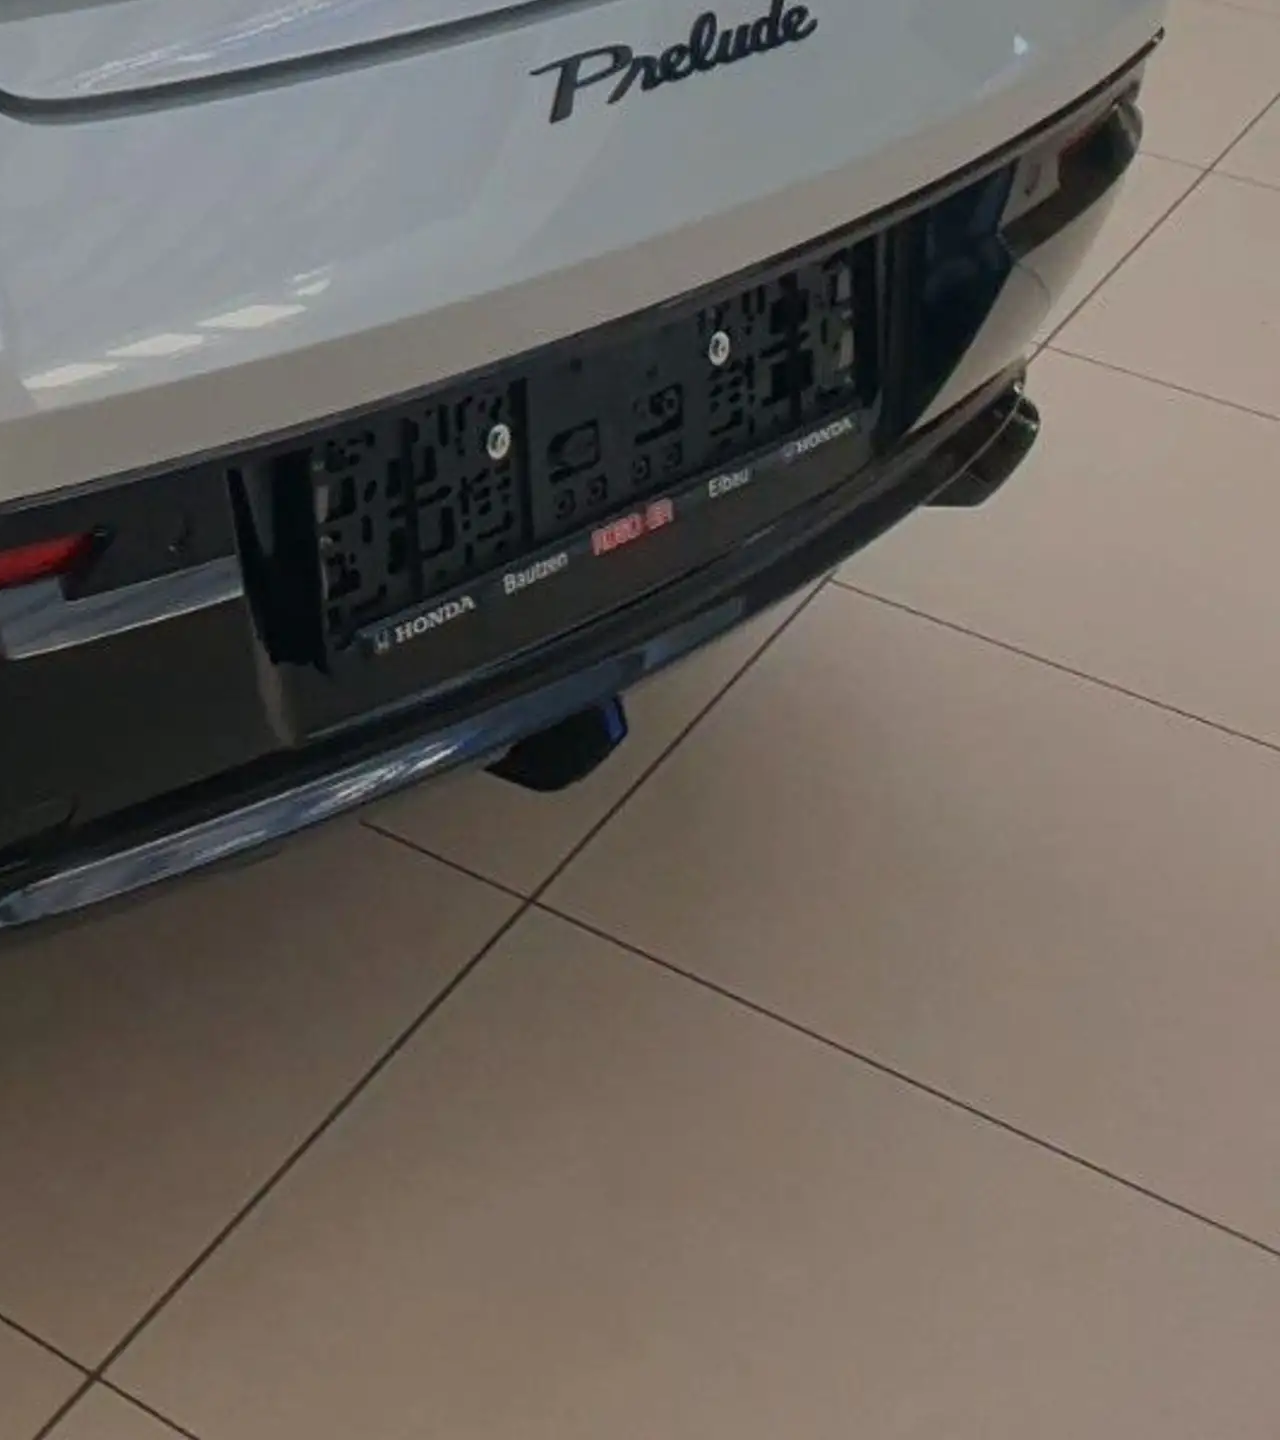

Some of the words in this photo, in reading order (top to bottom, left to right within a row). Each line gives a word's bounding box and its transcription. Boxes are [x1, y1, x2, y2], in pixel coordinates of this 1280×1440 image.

[394, 594, 477, 644] HONDA
[502, 550, 569, 596] Bautzen
[795, 416, 854, 455] HONDA
